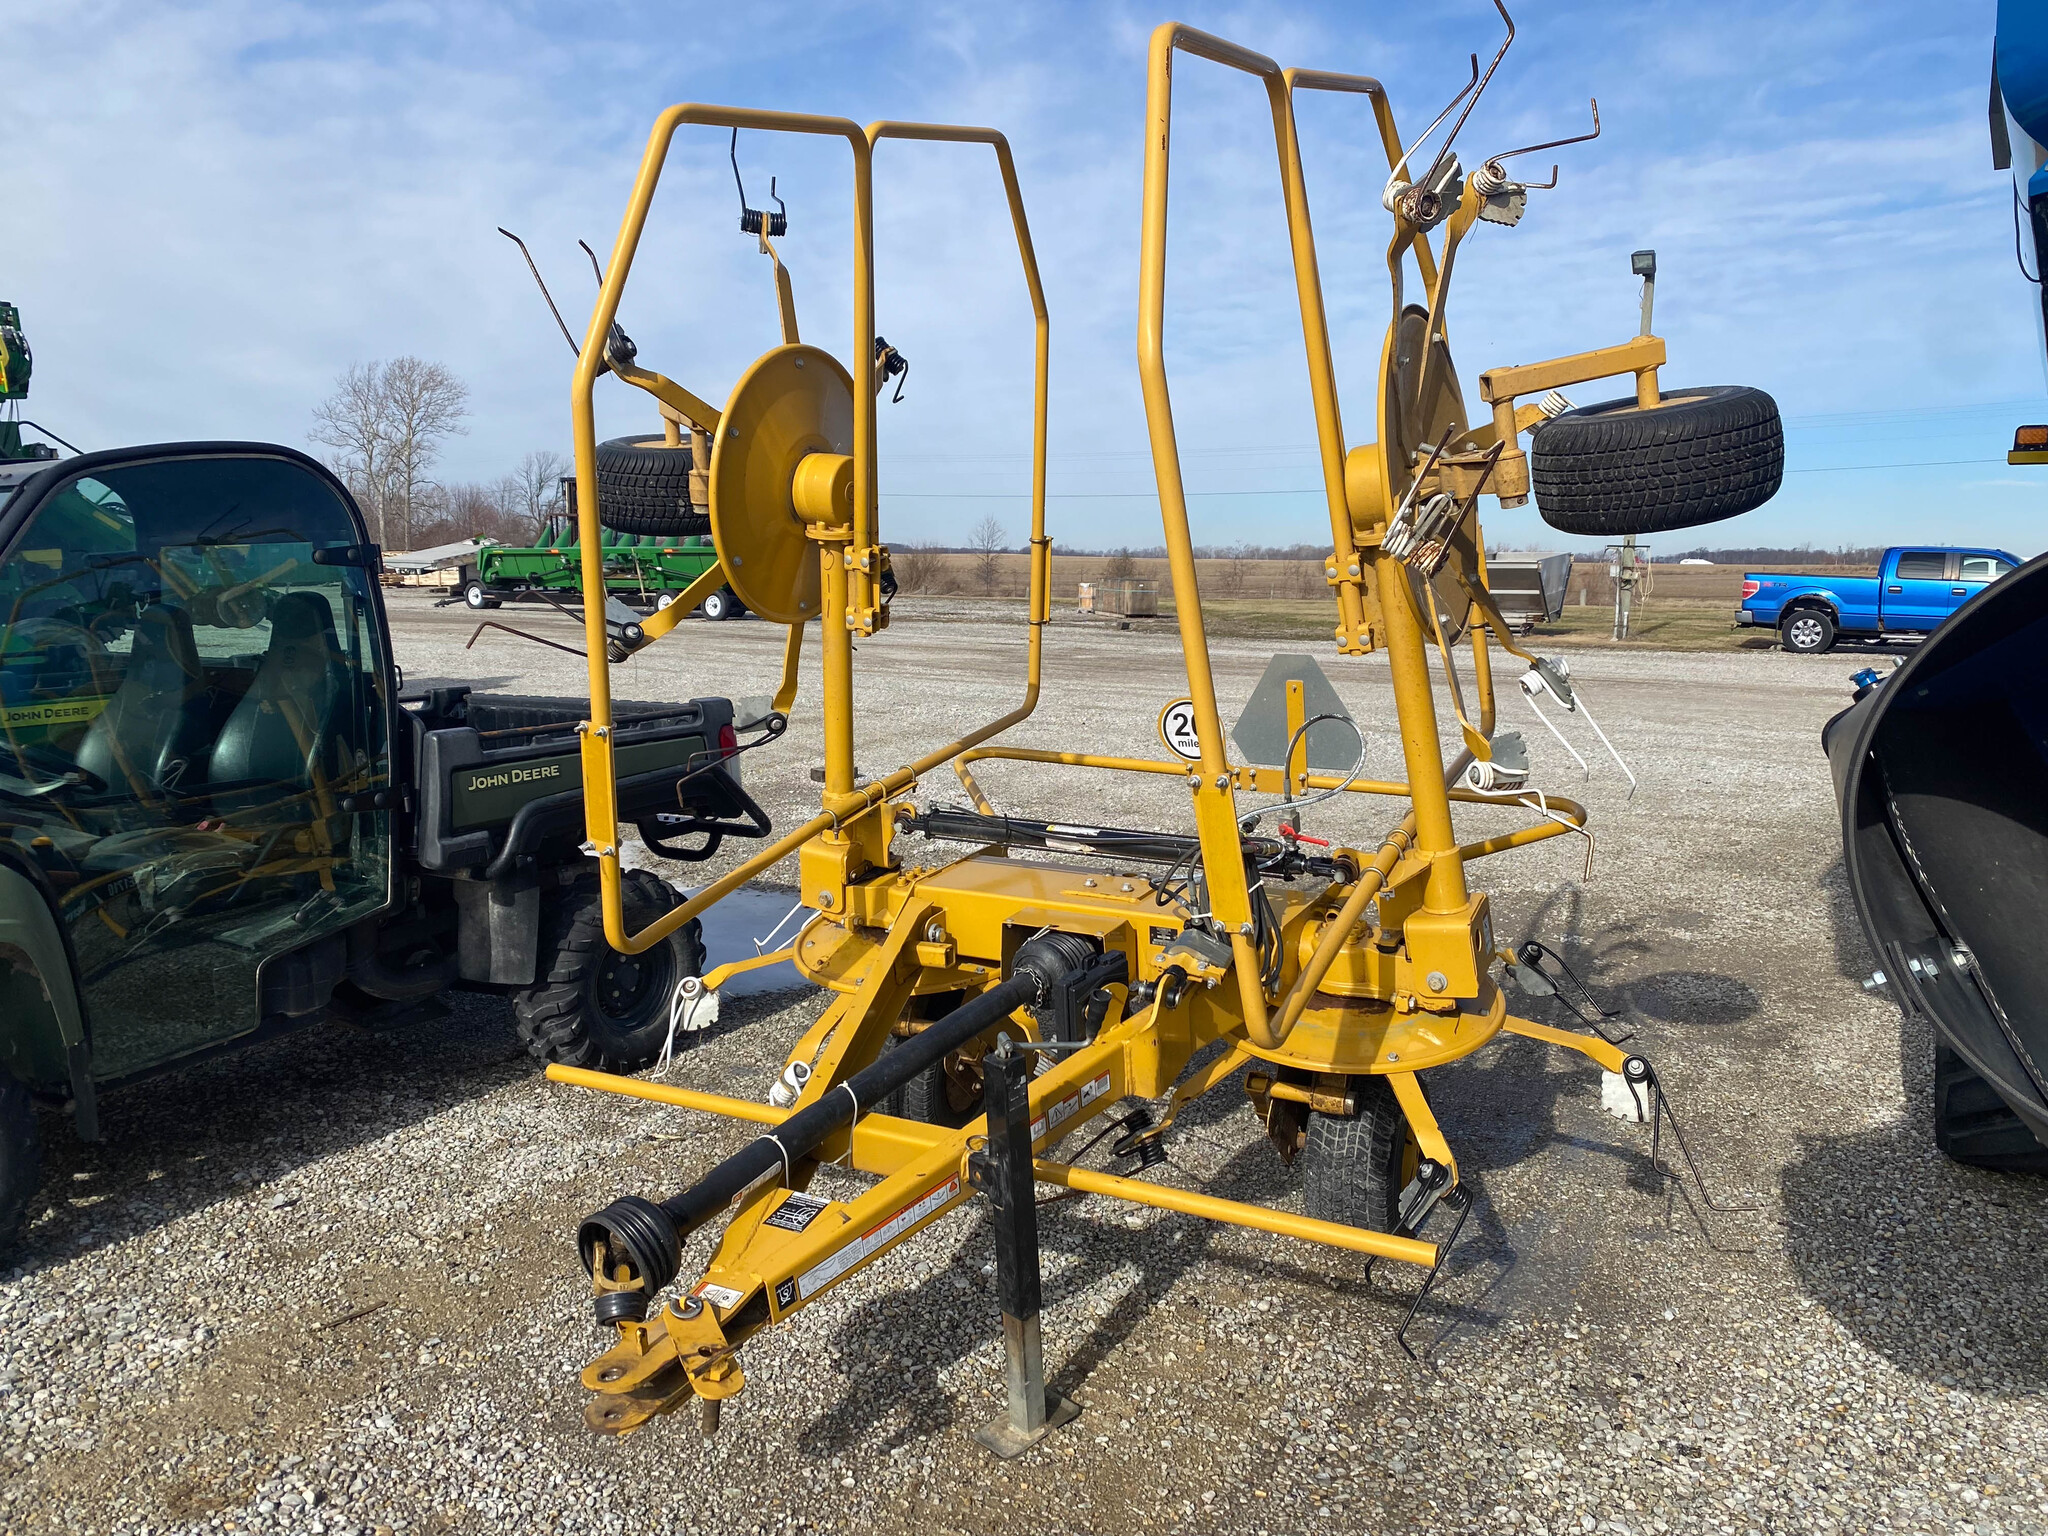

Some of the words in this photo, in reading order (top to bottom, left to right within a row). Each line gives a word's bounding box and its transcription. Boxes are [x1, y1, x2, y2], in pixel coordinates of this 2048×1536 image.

[4, 710, 41, 722] JOHN
[44, 706, 89, 719] DEERE
[468, 773, 508, 791] JOHN
[511, 765, 560, 783] DEERE
